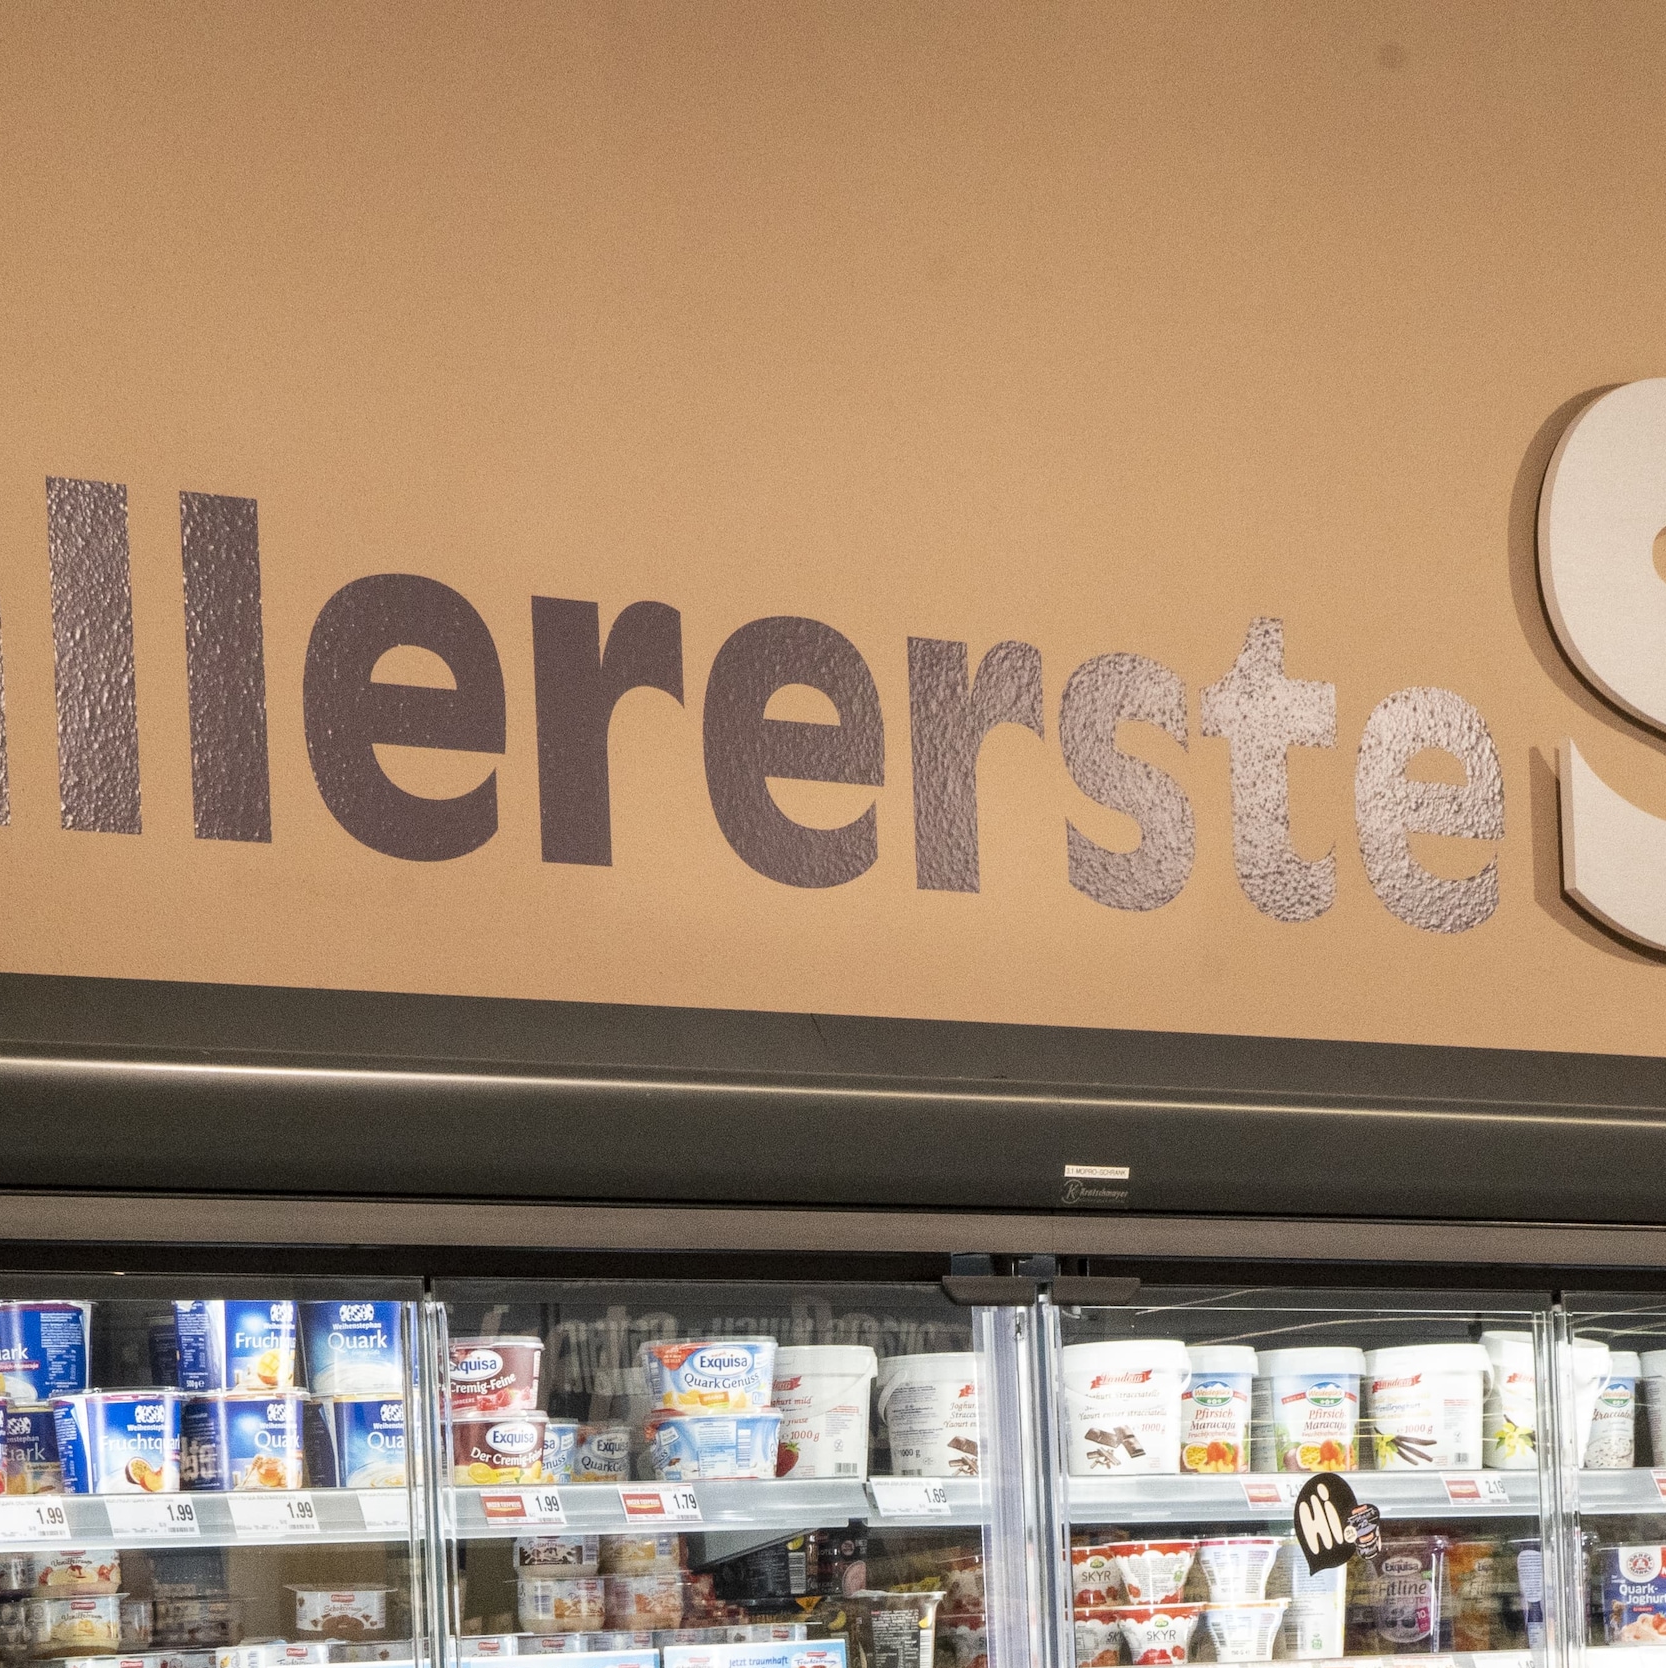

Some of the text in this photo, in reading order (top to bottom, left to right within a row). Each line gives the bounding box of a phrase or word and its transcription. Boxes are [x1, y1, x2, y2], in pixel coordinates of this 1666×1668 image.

[328, 1329, 389, 1351] Quark
[699, 1354, 748, 1372] Exquisa
[1302, 1421, 1347, 1432] Maracuja
[253, 1428, 300, 1452] Quark
[492, 1430, 534, 1447] Exquisa
[285, 1499, 314, 1519] 1.99
[535, 1495, 560, 1513] 1.99
[672, 1492, 697, 1510] 1.79
[35, 1506, 65, 1527] 1.99
[167, 1502, 195, 1522] 1.99
[1299, 1483, 1343, 1555] Hi
[1617, 1584, 1658, 1597] Quark-
[1146, 1628, 1177, 1642] SKYR
